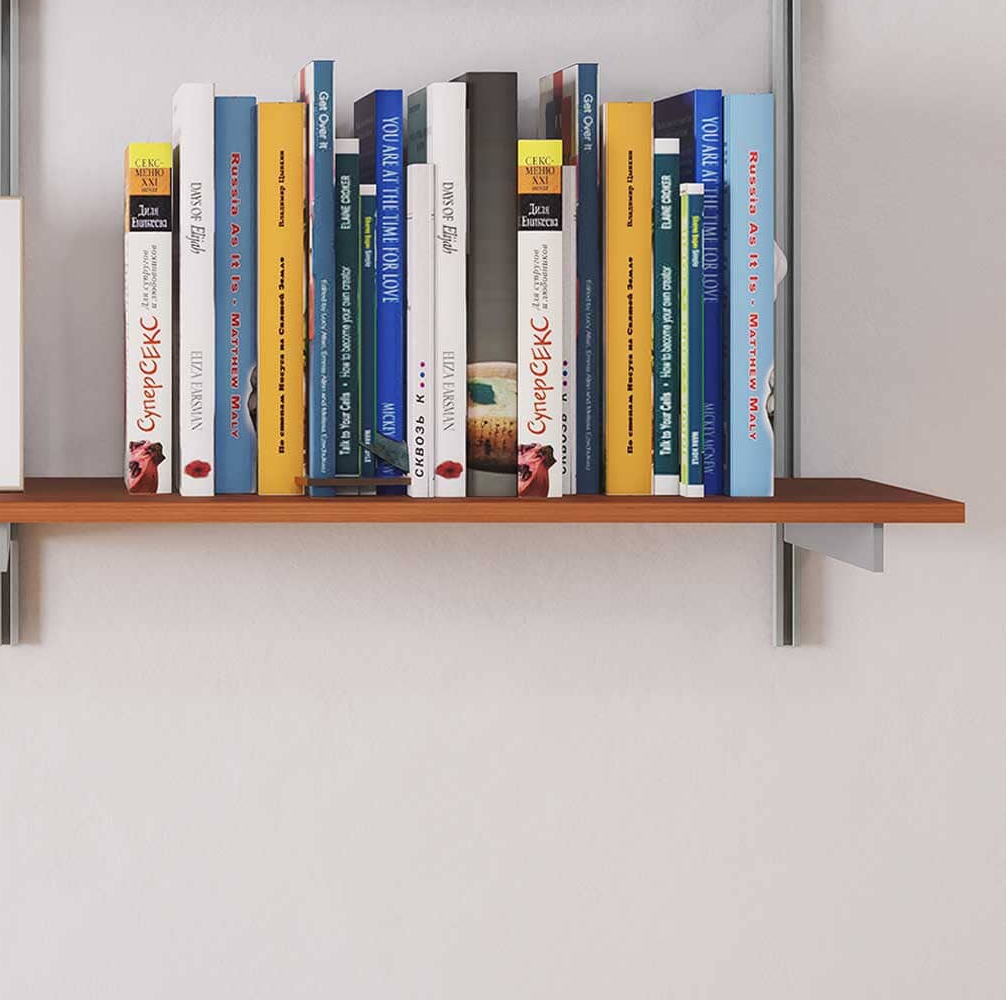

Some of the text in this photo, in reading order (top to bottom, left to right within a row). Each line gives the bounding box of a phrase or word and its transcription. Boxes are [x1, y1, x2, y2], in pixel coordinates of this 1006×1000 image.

[318, 91, 330, 111] Get
[582, 93, 594, 113] Get
[318, 113, 330, 140] Over
[582, 115, 594, 141] Over
[135, 168, 165, 177] МЕНЮ
[141, 178, 158, 187] XXI
[525, 166, 555, 175] МЕНЮ
[532, 176, 548, 185] XXI
[749, 150, 759, 215] Russia
[230, 152, 241, 217] Russia
[186, 182, 207, 255] DAYS OF Elijah
[382, 116, 400, 304] YOU ARE AT THE TIME FOR LOVE
[438, 182, 459, 255] DAYS OF Elijah
[702, 116, 720, 304] YOU ARE AT THE TIME FOR LOVE
[230, 223, 241, 248] As
[749, 222, 759, 247] As
[230, 253, 241, 269] It
[749, 253, 759, 269] It
[230, 274, 241, 293] Is
[749, 275, 759, 293] Is
[230, 312, 241, 389] MATTHEW
[749, 313, 759, 390] MATTHEW
[136, 316, 163, 433] СуперСЕКС
[527, 317, 554, 435] СуперСЕКС
[191, 350, 203, 431] ELIZA EARSMAN
[443, 350, 455, 431] ELIZA EARSMAN
[230, 394, 241, 440] MALY
[339, 411, 351, 429] Your
[381, 402, 397, 437] MICKEY
[659, 411, 671, 429] Your
[703, 402, 716, 437] MICKEY
[749, 397, 759, 441] MALY
[278, 438, 285, 454] По
[339, 440, 351, 456] Talk
[414, 416, 425, 478] СКВОЗЬ
[627, 438, 634, 454] По
[659, 440, 671, 456] Talk
